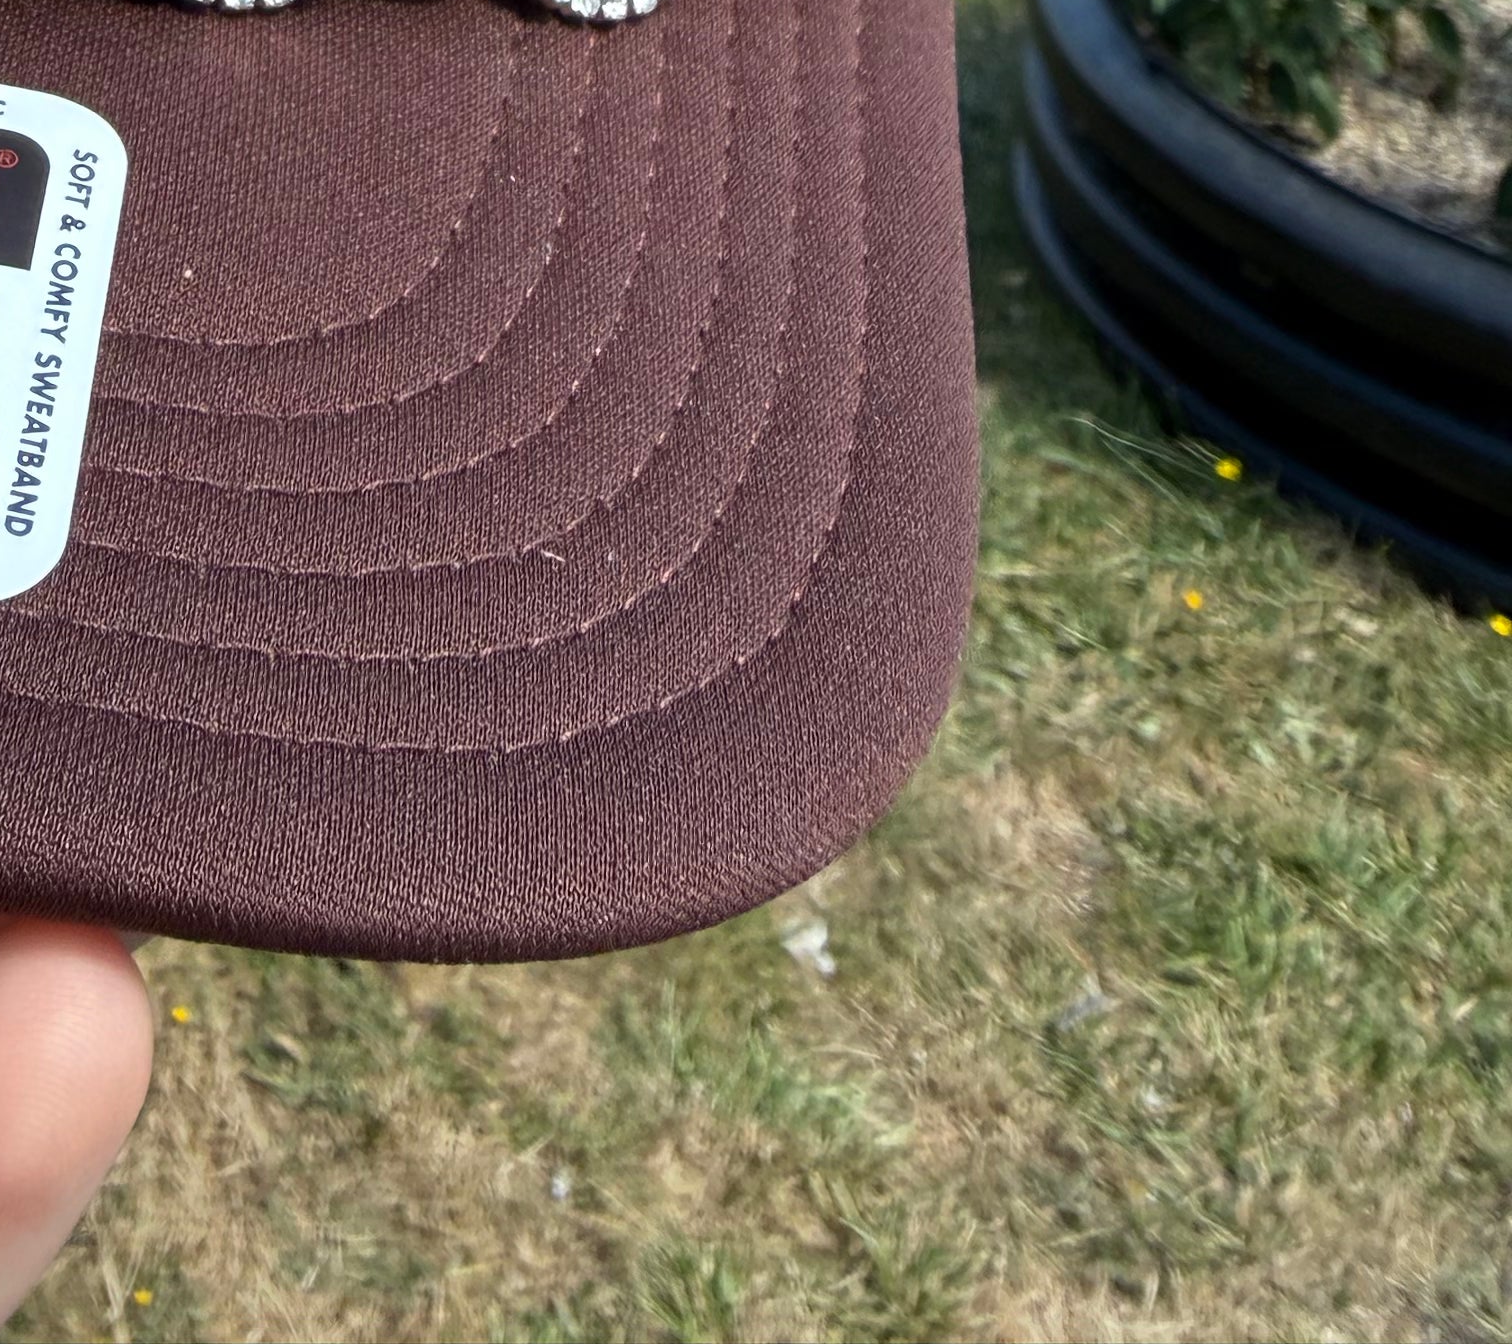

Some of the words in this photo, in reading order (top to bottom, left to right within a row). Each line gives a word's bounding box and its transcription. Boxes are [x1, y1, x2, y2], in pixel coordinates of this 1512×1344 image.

[64, 148, 99, 210] SOFT
[58, 213, 87, 233] &
[39, 242, 83, 345] COMFY
[3, 350, 64, 538] SWEATBAND
